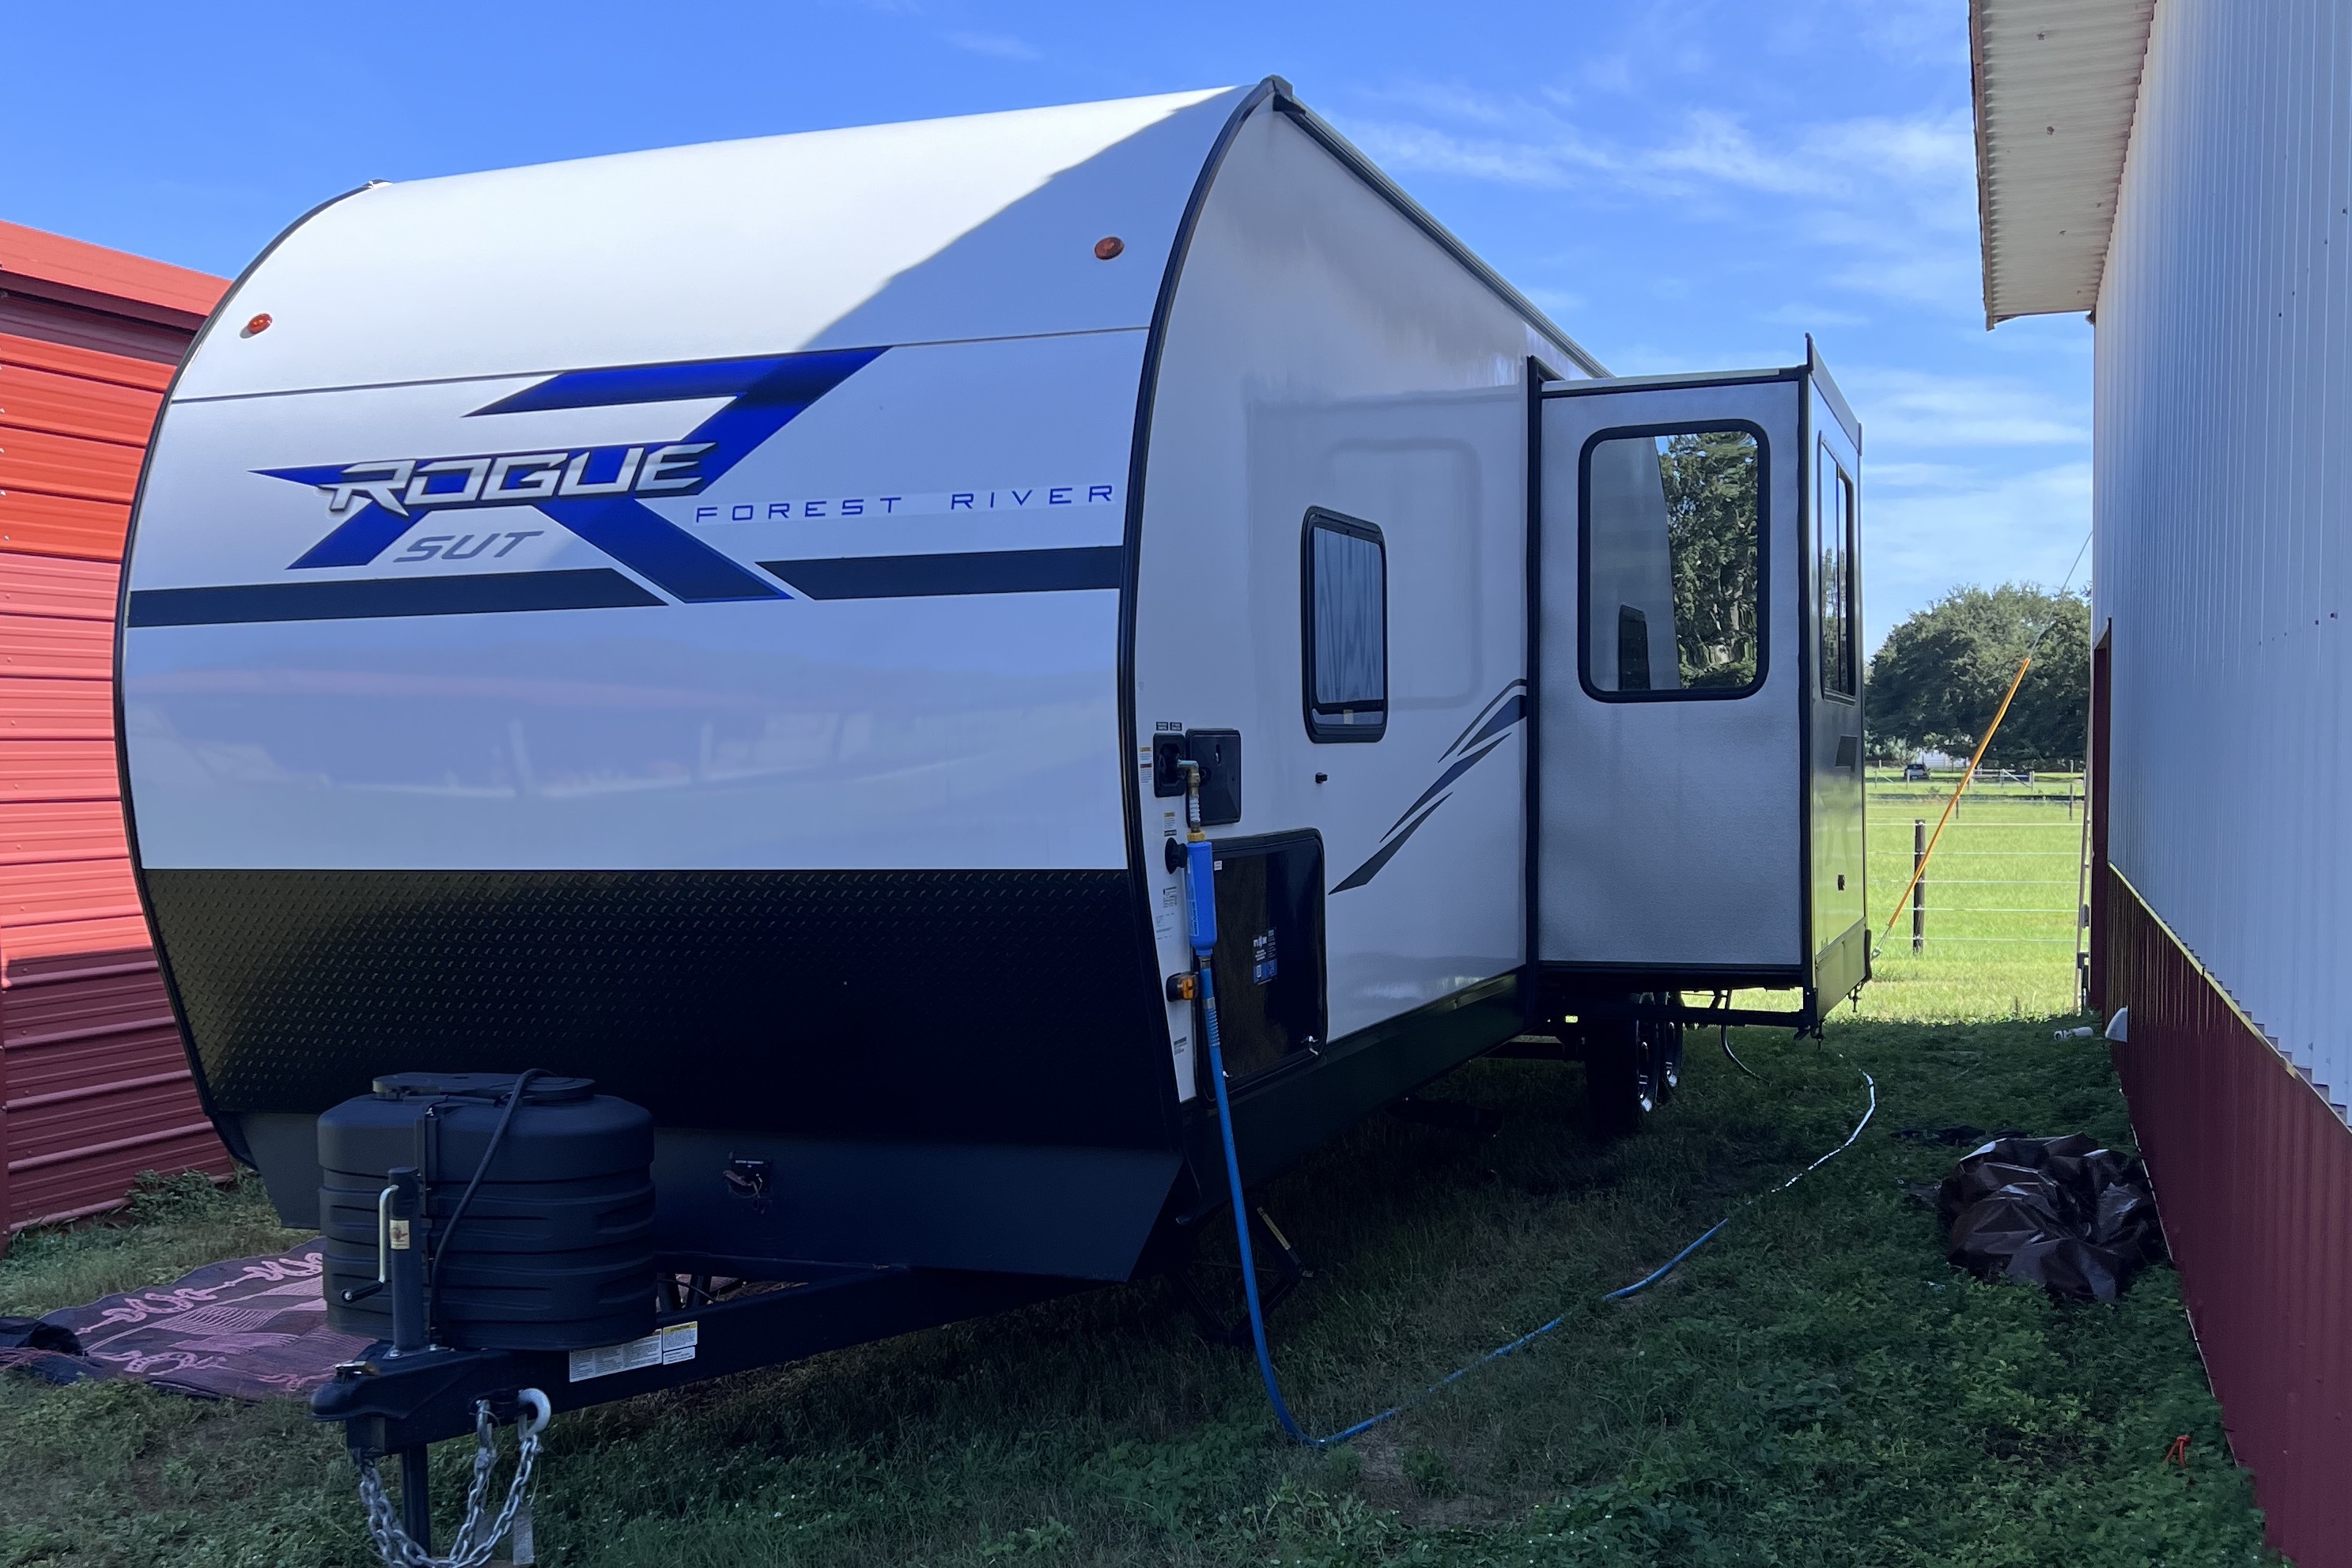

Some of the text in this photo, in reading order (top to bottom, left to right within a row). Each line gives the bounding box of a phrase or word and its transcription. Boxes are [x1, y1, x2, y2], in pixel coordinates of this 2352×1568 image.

[318, 442, 717, 517] ROGUE
[696, 485, 1113, 523] FOREST RIVER
[393, 530, 545, 563] SUT
